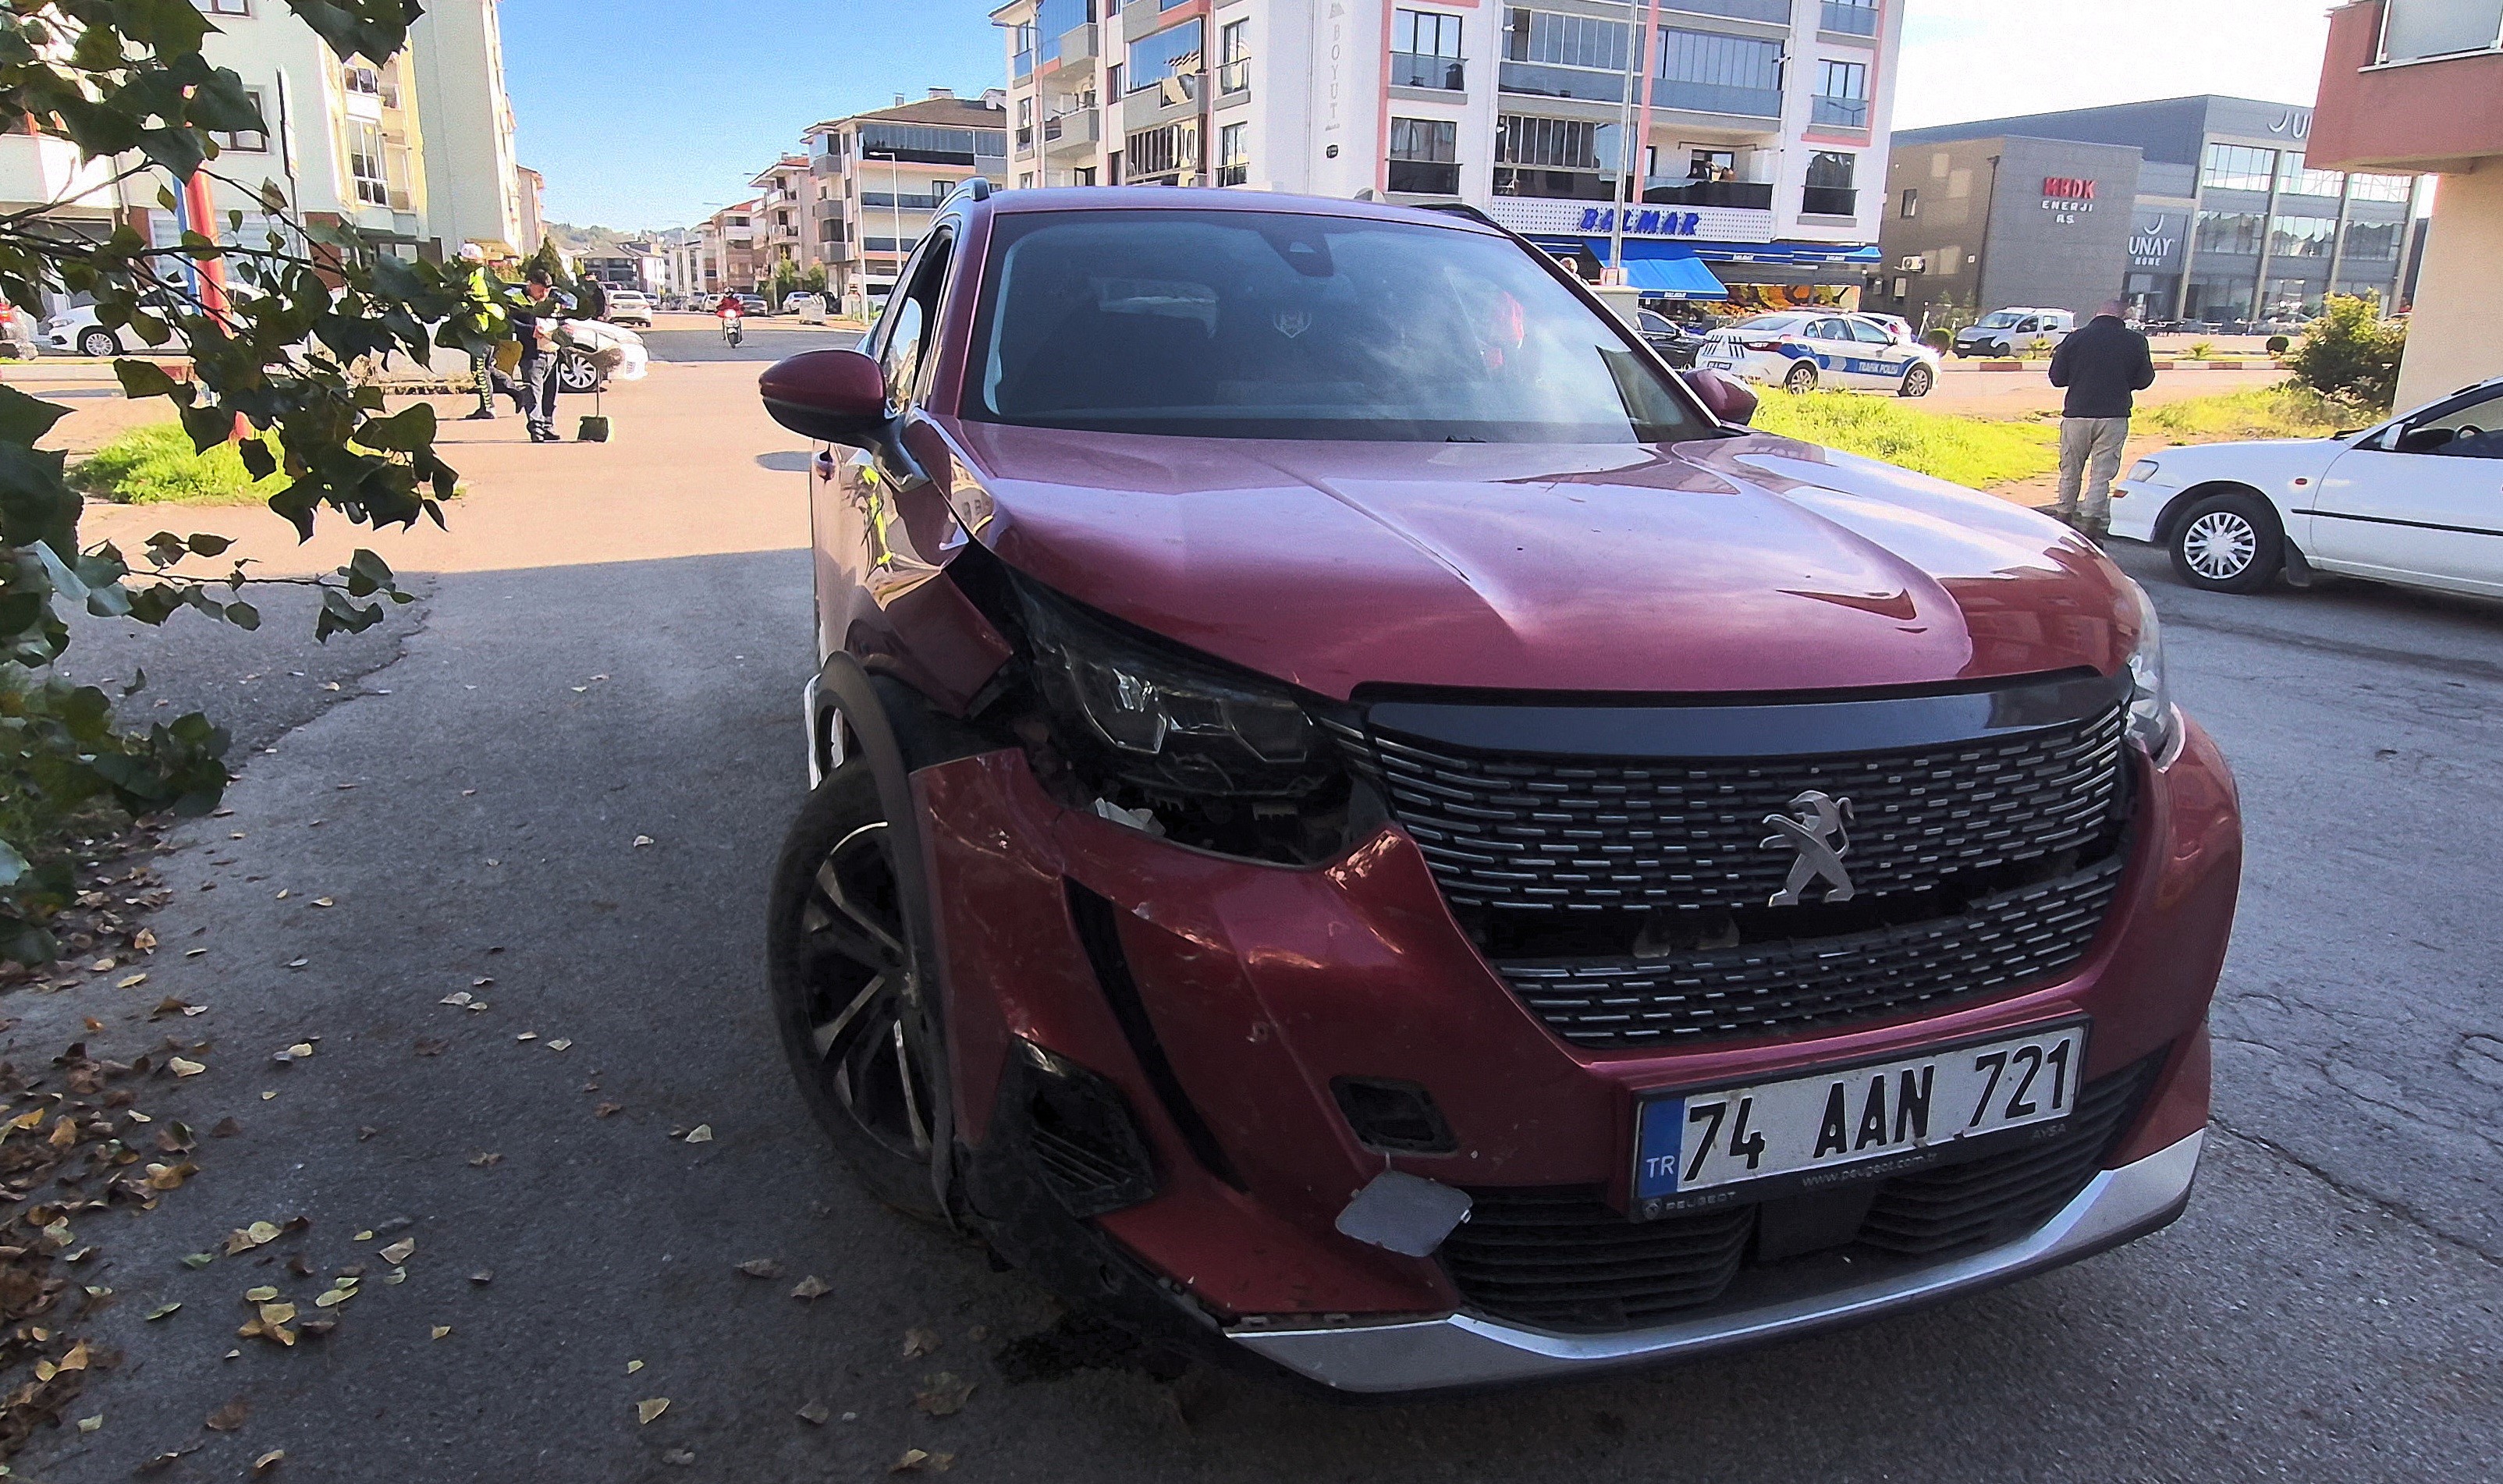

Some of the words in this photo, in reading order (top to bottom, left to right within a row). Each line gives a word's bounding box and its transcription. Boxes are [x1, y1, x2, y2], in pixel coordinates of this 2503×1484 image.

[1578, 208, 1699, 236] BALMAR
[2128, 236, 2172, 257] UNAY
[1684, 1097, 1766, 1182] 74
[1812, 1065, 1935, 1159] AAN
[1969, 1038, 2071, 1127] 721
[1646, 1155, 1676, 1179] TR
